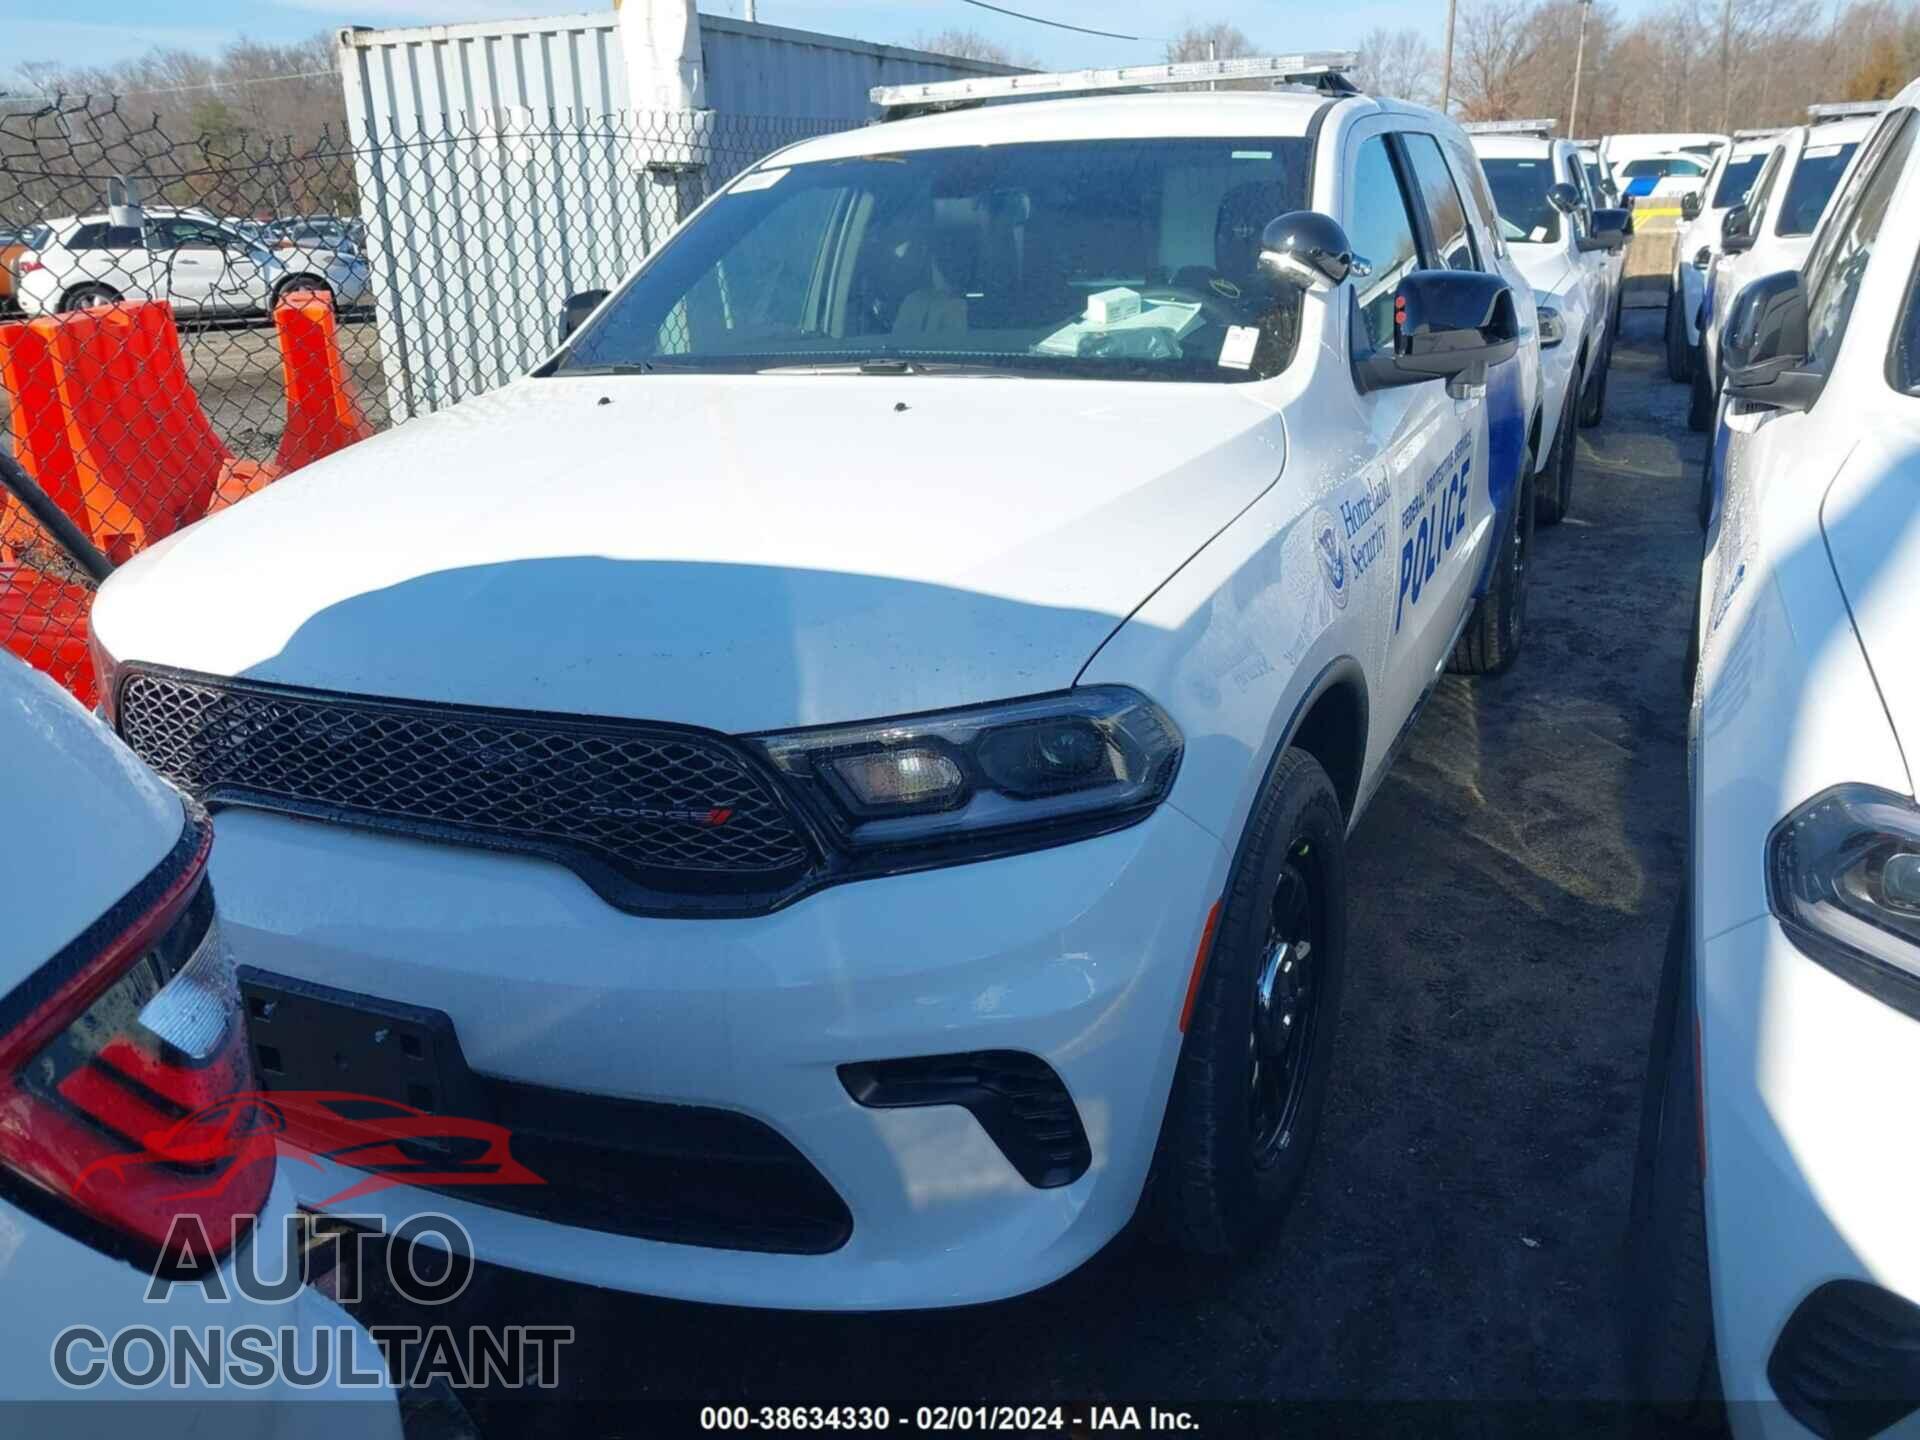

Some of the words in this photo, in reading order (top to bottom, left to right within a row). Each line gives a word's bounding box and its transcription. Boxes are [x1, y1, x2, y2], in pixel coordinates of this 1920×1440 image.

[1339, 464, 1391, 540] Homeland
[1350, 520, 1386, 580] Security
[1395, 456, 1470, 635] POLICE
[588, 806, 714, 822] DODGE
